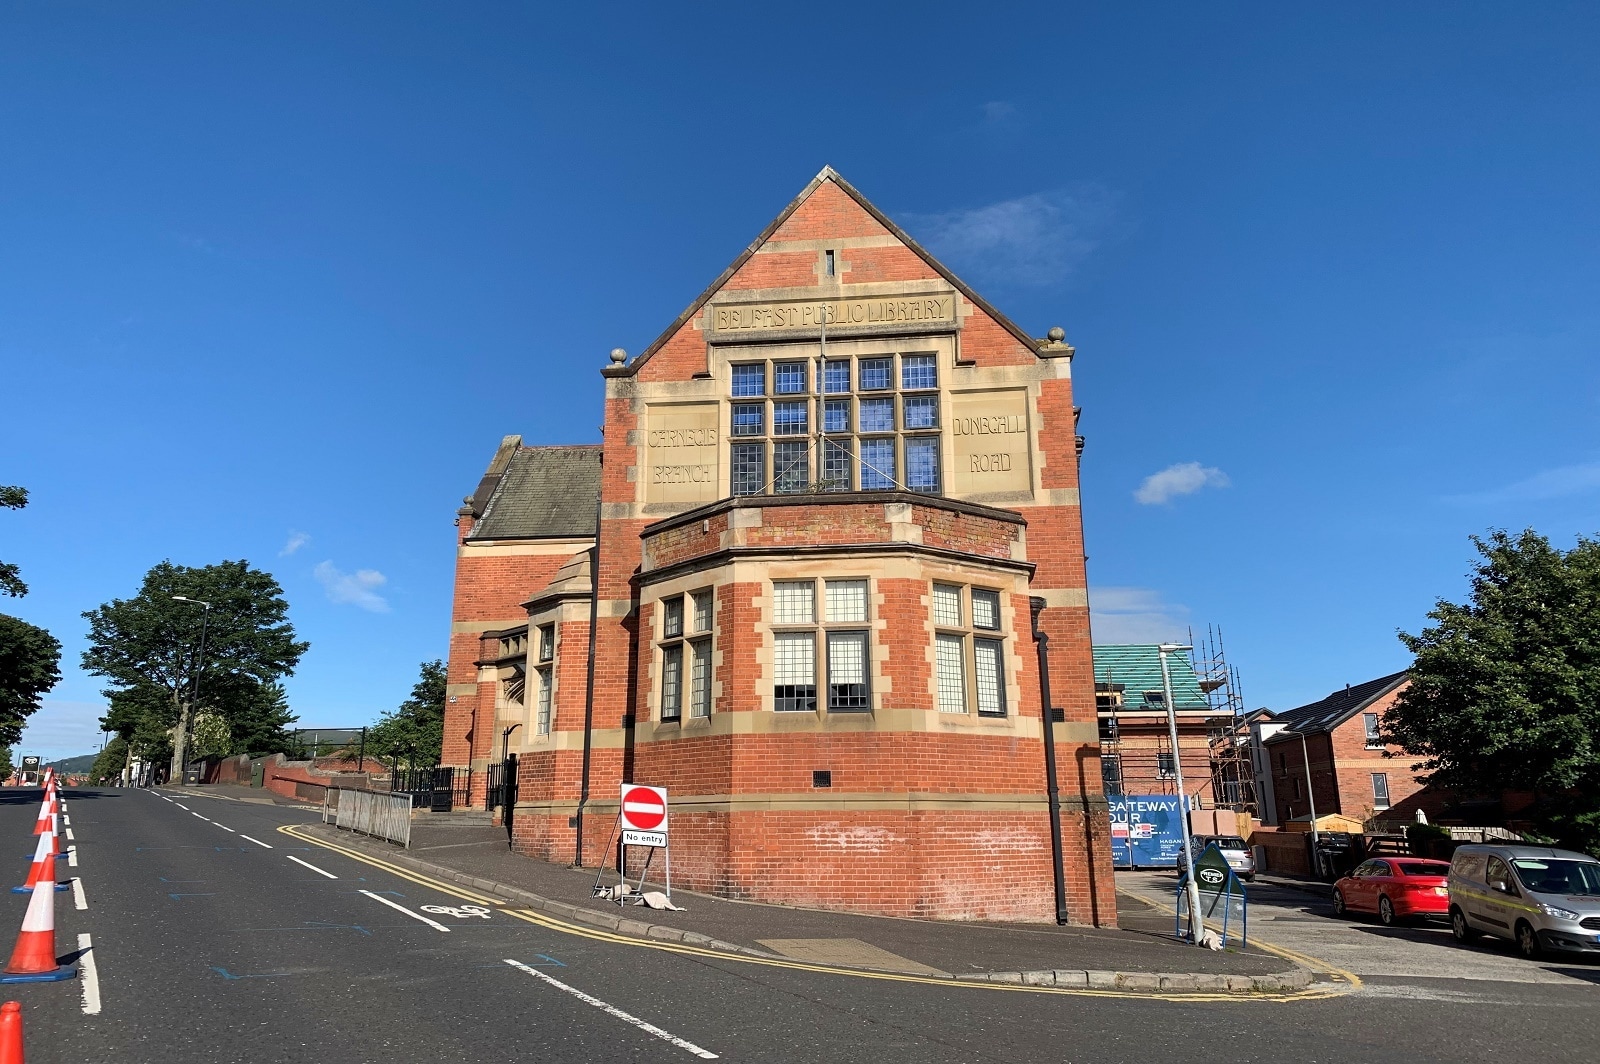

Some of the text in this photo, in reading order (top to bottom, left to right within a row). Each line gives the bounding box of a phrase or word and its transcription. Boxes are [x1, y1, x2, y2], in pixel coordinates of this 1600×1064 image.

[718, 298, 948, 329] BELFAST PUBLIC LIBRARY
[953, 416, 1026, 436] DONEGALL
[648, 428, 716, 447] CARNEGIE
[970, 453, 1011, 472] ROAD
[653, 465, 711, 484] BRANCH
[1109, 801, 1177, 811] GATEWAY
[627, 833, 638, 841] No
